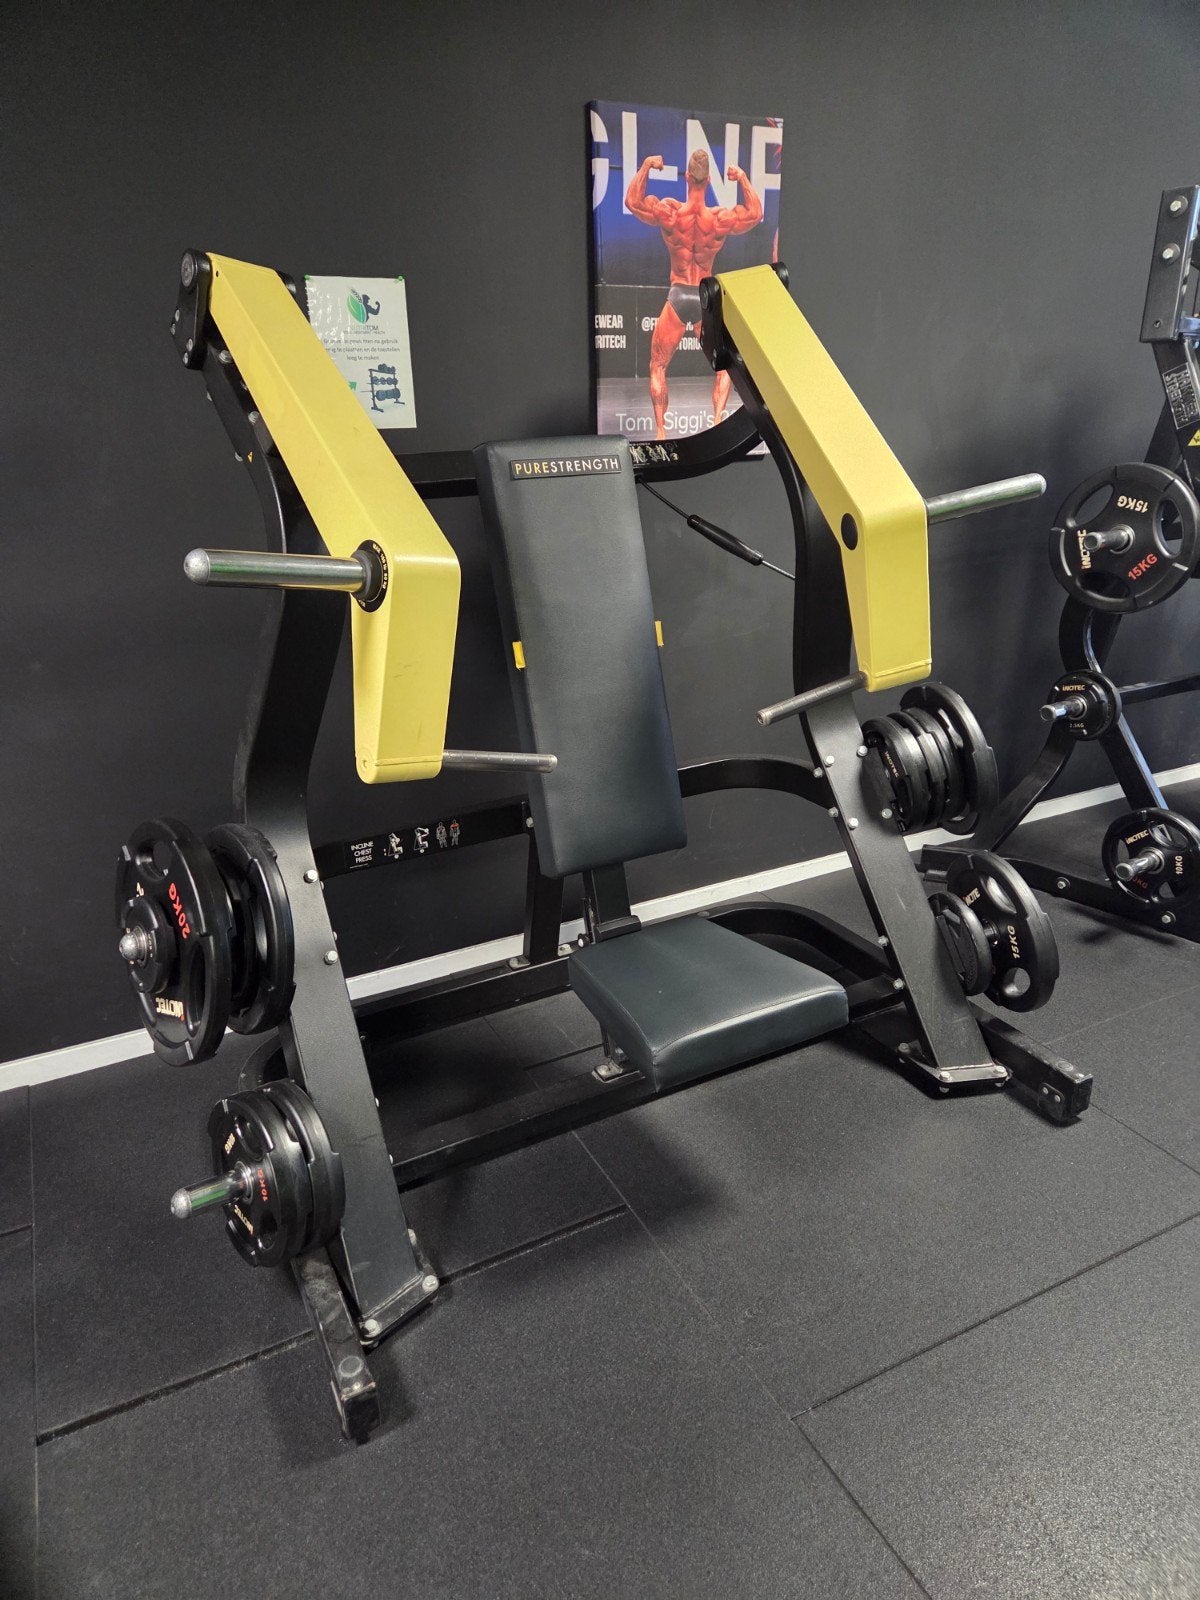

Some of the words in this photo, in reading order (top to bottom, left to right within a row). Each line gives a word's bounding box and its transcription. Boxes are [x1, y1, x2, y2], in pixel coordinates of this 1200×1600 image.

[616, 413, 653, 431] Tom
[663, 410, 715, 434] Siggi's
[514, 458, 619, 475] PURESTRENGTH
[1116, 495, 1149, 513] 15KG
[1127, 553, 1159, 580] 15KG
[351, 841, 374, 851] INCLINE
[354, 848, 372, 857] CHEST
[355, 855, 372, 863] PRESS
[1174, 855, 1184, 875] 10KG
[168, 882, 191, 939] 20KG
[1007, 925, 1021, 959] 15KG
[257, 1168, 268, 1202] 10KG
